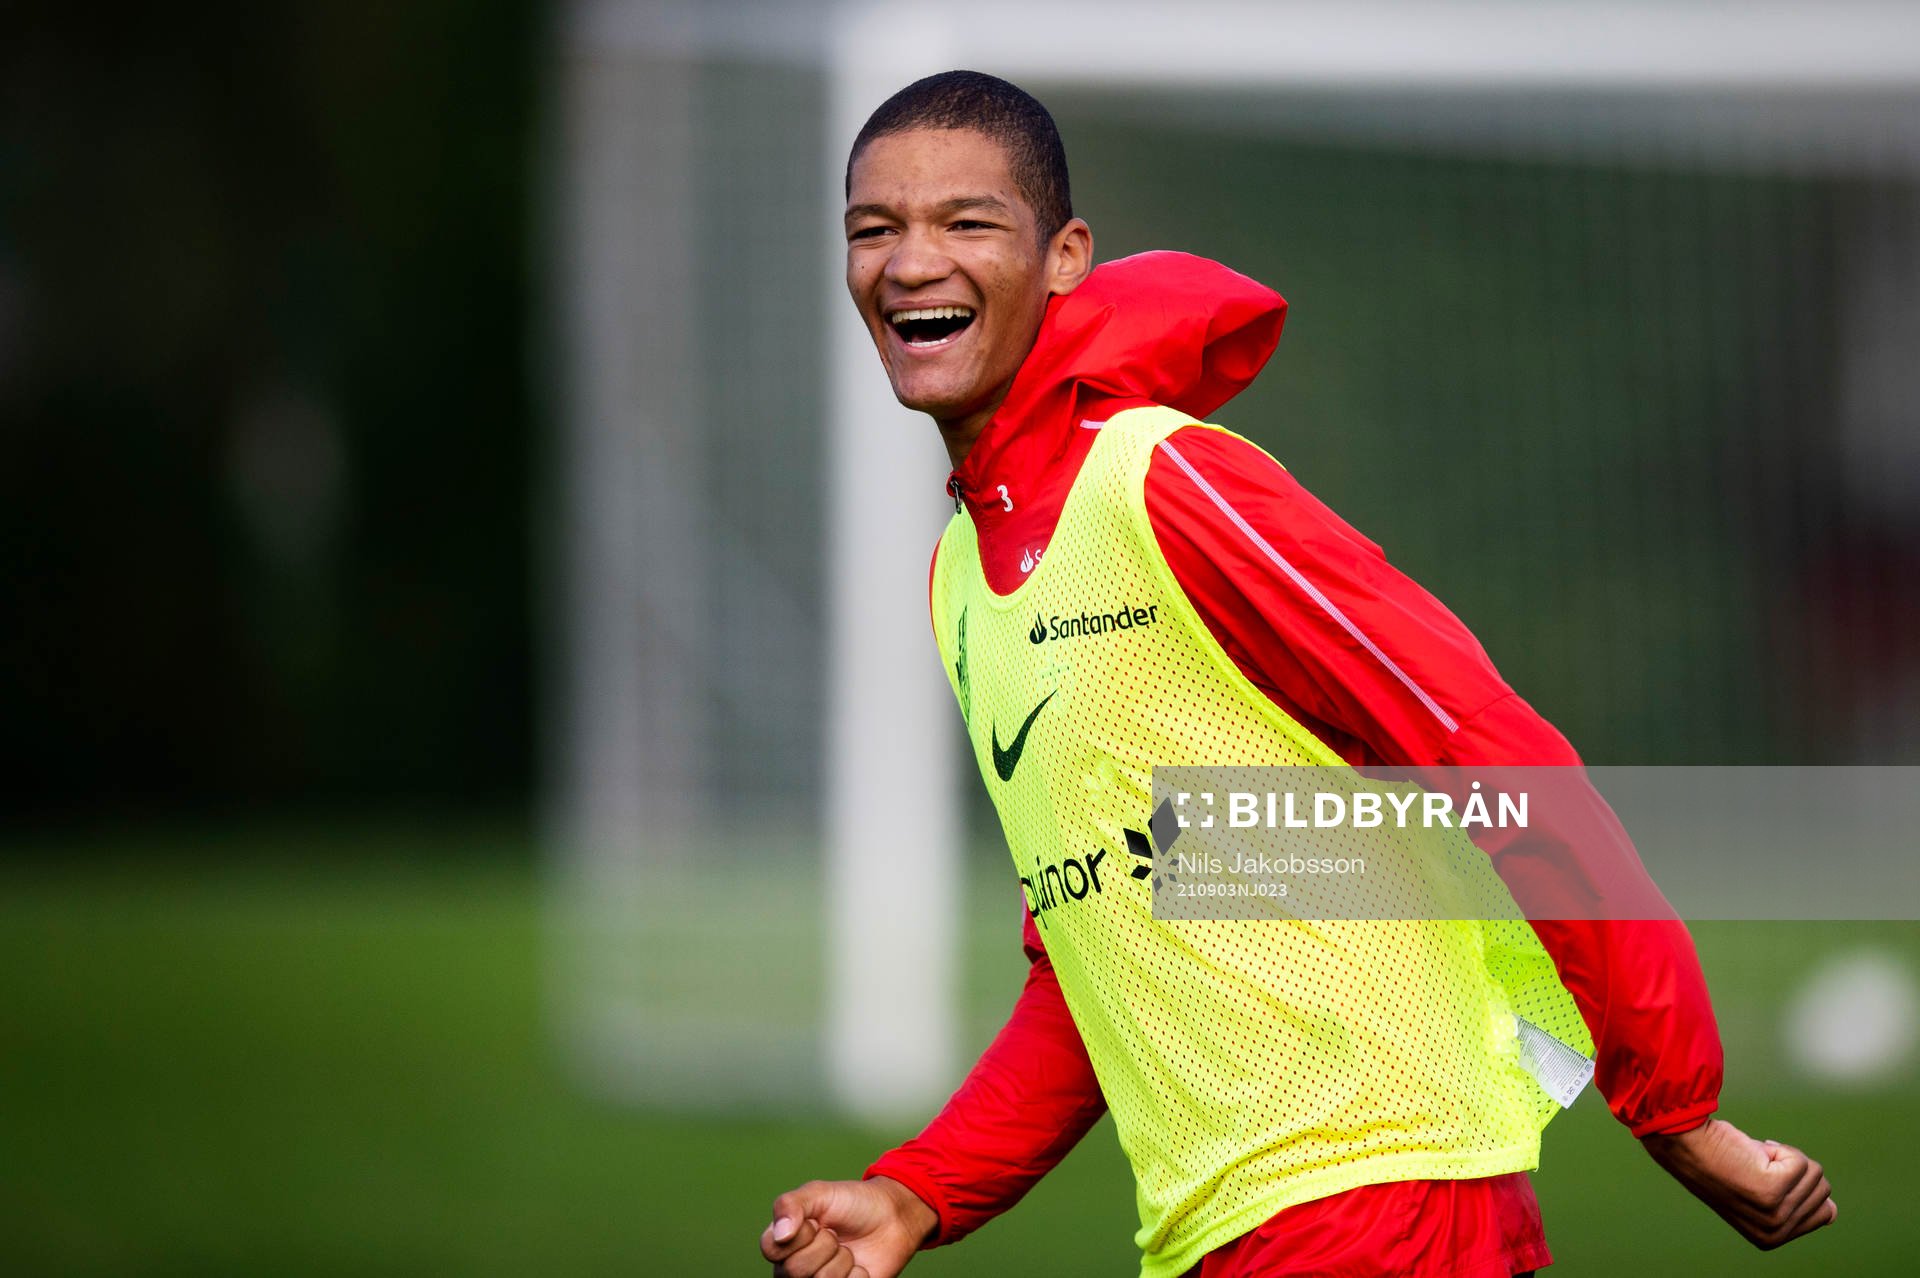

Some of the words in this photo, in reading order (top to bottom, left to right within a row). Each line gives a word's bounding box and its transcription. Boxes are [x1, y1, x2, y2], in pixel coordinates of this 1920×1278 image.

[996, 484, 1014, 513] 3
[1049, 604, 1159, 642] Santander
[1020, 847, 1107, 930] quinor
